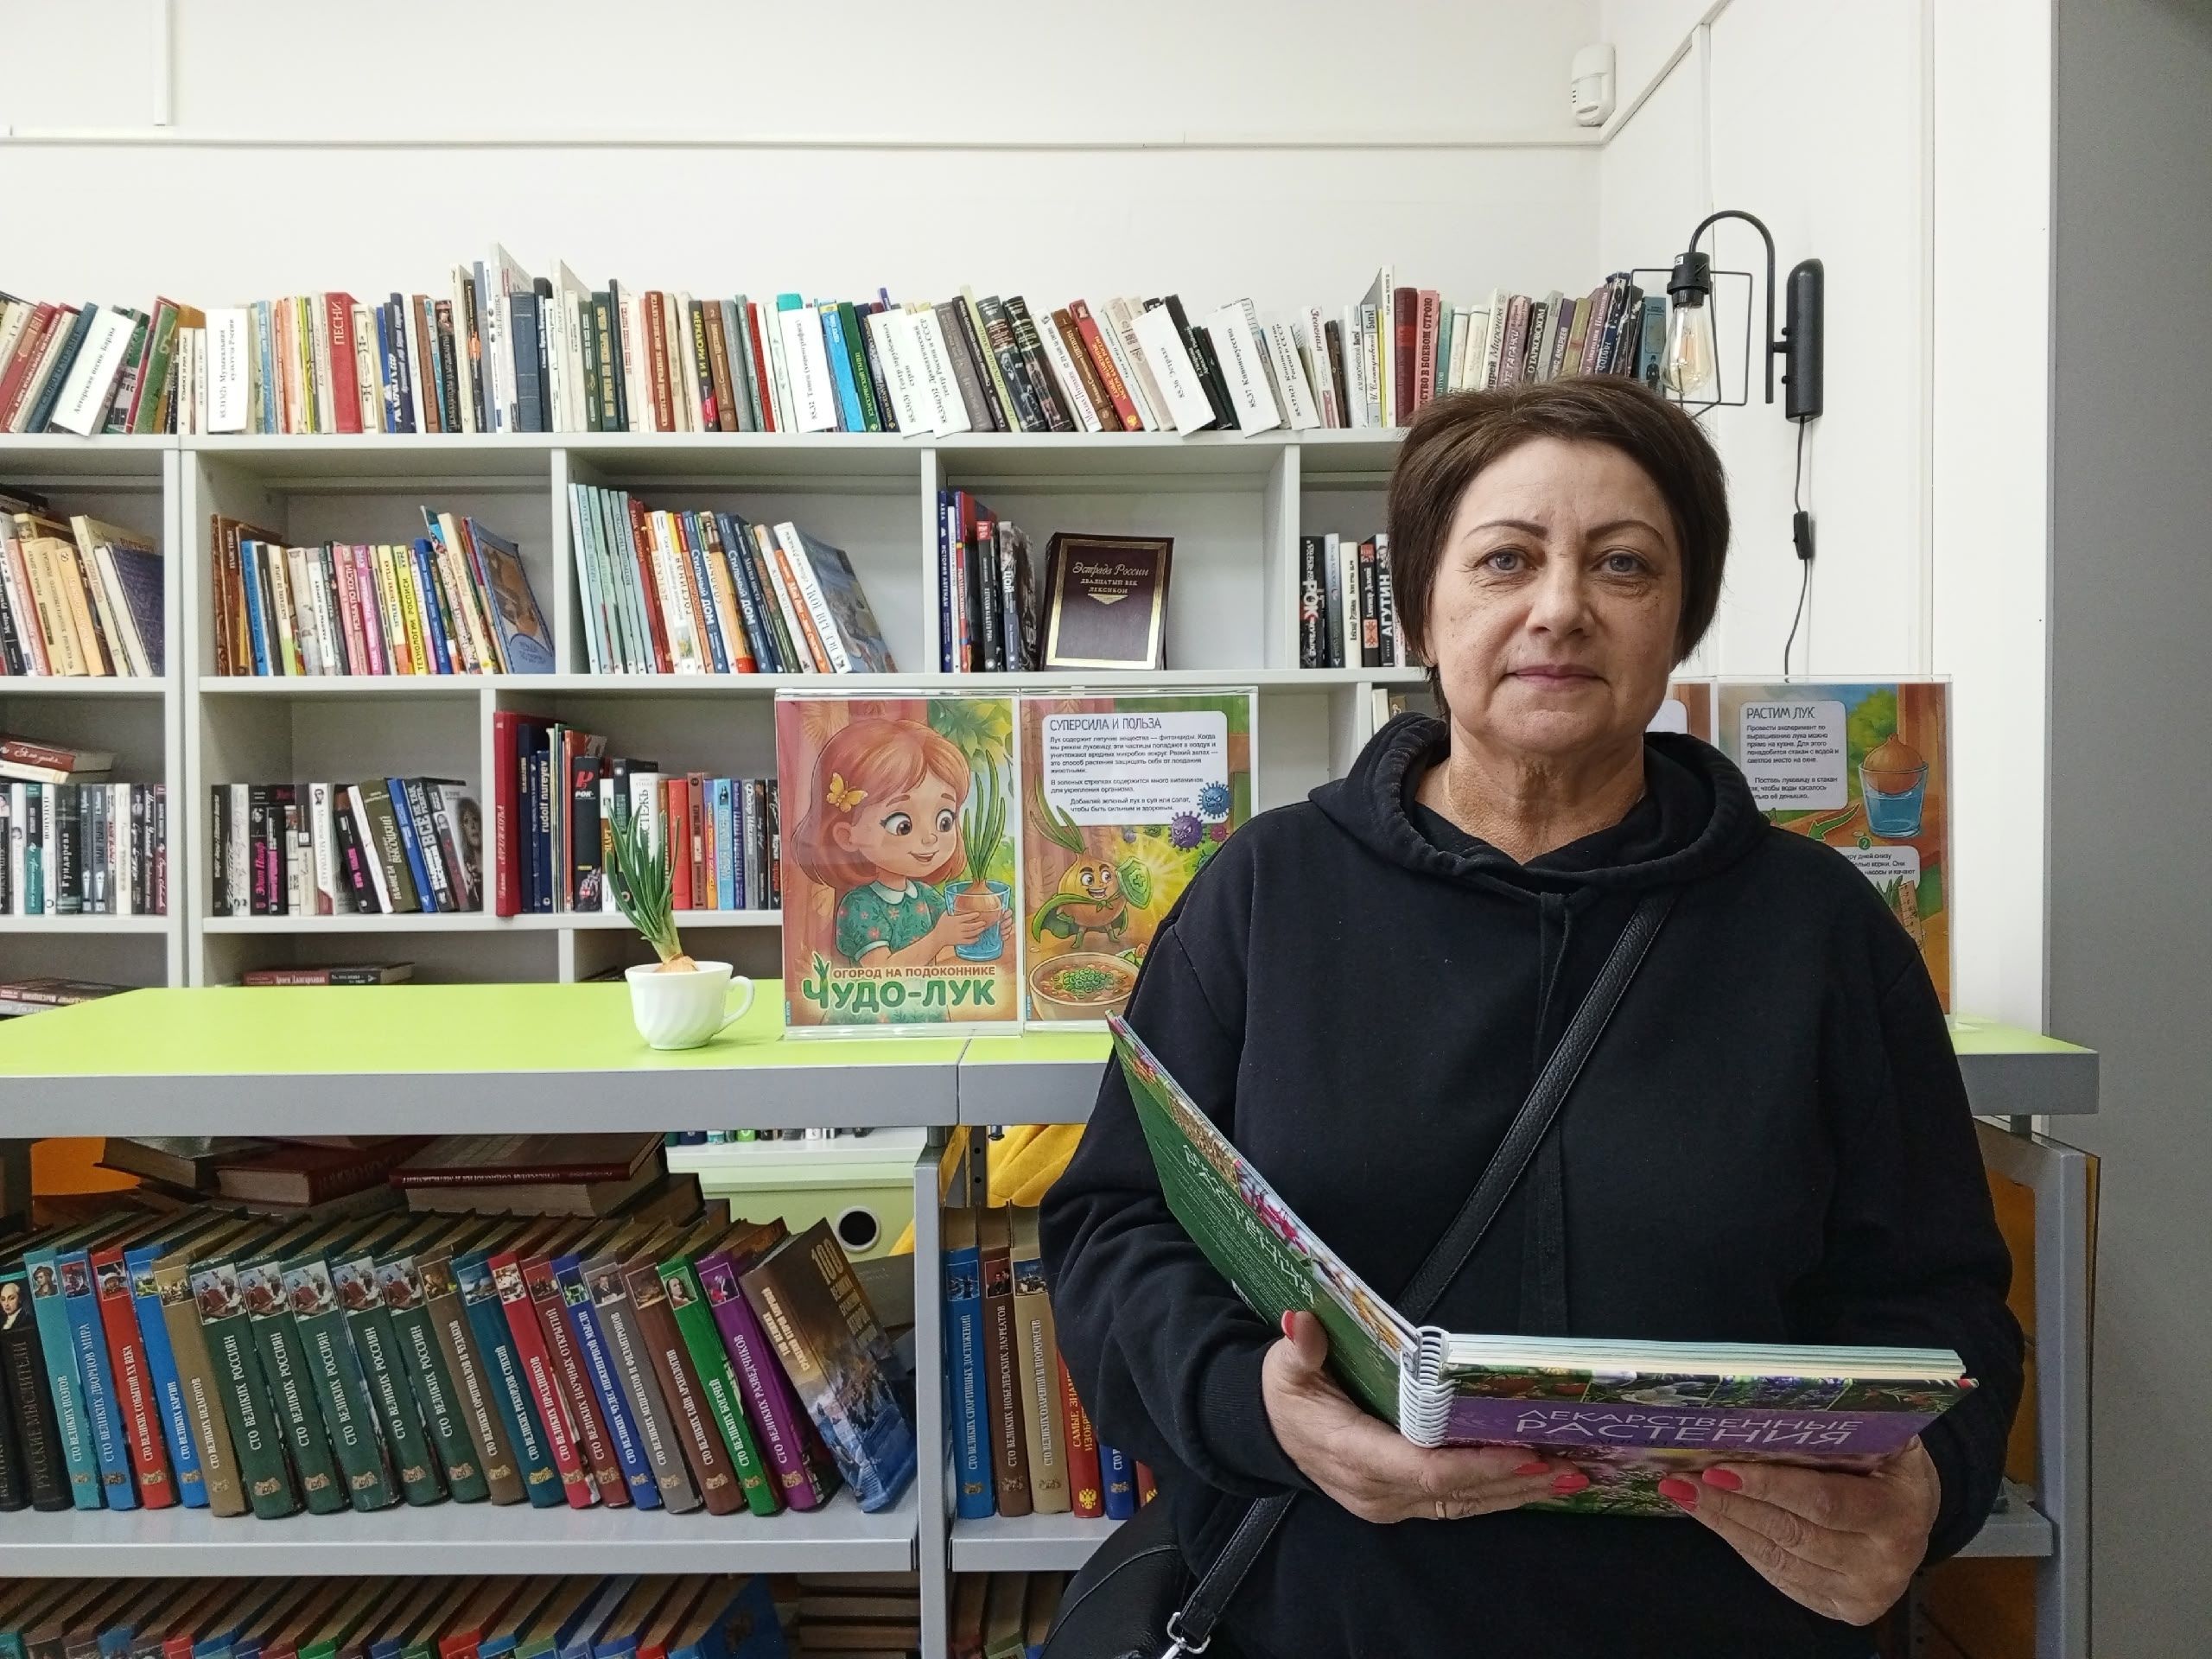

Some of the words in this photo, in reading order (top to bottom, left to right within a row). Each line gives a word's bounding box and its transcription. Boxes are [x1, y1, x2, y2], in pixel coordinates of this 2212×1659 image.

[332, 302, 345, 346] ПЕСНИ
[1365, 310, 1376, 329] Быть!
[1422, 297, 1433, 328] СТРОЮ
[694, 311, 705, 359] МЕРКЬЮРИ
[1421, 331, 1432, 368] БОЕВОМ
[1489, 307, 1503, 359] Миронов
[1528, 308, 1546, 364] ТАРКОВСКОМ
[1554, 327, 1567, 359] АНДРЕЕВ
[691, 549, 708, 597] Стильный
[701, 598, 714, 626] ДОМ
[1072, 562, 1112, 576] Эстрада
[1114, 564, 1149, 576] России
[1080, 577, 1124, 587] ДВАДЦАТЫЙ
[401, 577, 415, 615] РОСПИСИ
[728, 550, 748, 597] Стильный
[741, 598, 756, 626] ДОМ
[1379, 574, 1393, 637] АГУТИН
[410, 620, 423, 671] ТЕХНОЛОГИИ
[1050, 719, 1109, 732] СУПЕРСИЛА
[1112, 718, 1119, 730] И
[1122, 717, 1162, 730] ПОЛЬЗА
[1746, 708, 1791, 720] РАСТИМ
[1793, 707, 1815, 720] ЛУК
[539, 760, 550, 800] nureyev
[539, 802, 550, 833] rudolf
[61, 832, 73, 887] Гундарева
[833, 969, 882, 981] ОГОРОД
[886, 968, 902, 978] НА
[906, 966, 996, 980] ПОДОКОННИКЕ
[803, 979, 996, 1014] ЧУДО-ЛУК
[1185, 1149, 1313, 1303] РАСТЕНИЯ
[811, 1238, 844, 1285] 100
[79, 1323, 95, 1350] МИРА
[546, 1307, 572, 1357] ОТКРЫТИЙ
[579, 1310, 596, 1339] МЫСЛИ
[960, 1314, 974, 1366] ДОСТИЖЕНИЙ
[996, 1305, 1009, 1351] ЛАУРЕАТОВ
[122, 1344, 135, 1363] ВЕКА
[223, 1335, 245, 1381] РОССИЯН
[270, 1332, 292, 1377] РОССИЯН
[588, 1339, 613, 1390] ИНЖЕНЕРНОЙ
[734, 1333, 764, 1399] РАЗВЕДЧИКОВ
[12, 1341, 41, 1427] МЫСЛИТЕЛИ
[57, 1376, 73, 1408] ПОЭТОВ
[83, 1352, 105, 1395] ДВОРЦОВ
[531, 1357, 555, 1408] ПРАЗДНИКОВ
[562, 1357, 586, 1399] НАУЧНЫХ
[1001, 1352, 1014, 1409] НОБЕЛЕВСКИХ
[126, 1376, 144, 1412] СОБЫТИЙ
[236, 1383, 258, 1427] ВЕЛИКИХ
[284, 1380, 305, 1424] ВЕЛИКИХ
[607, 1390, 622, 1414] ЧУДЕС
[709, 1378, 731, 1414] БОГАЧЕЙ
[963, 1367, 976, 1419] СПОРТИВНЫХ
[63, 1408, 79, 1445] ВЕЛИКИХ
[93, 1398, 111, 1440] ВЕЛИКИХ
[133, 1412, 151, 1446] ВЕЛИКИХ
[296, 1427, 310, 1446] СТО
[549, 1408, 568, 1445] ВЕЛИКИХ
[578, 1400, 600, 1440] ВЕЛИКИХ
[614, 1414, 634, 1449] ВЕЛИКИХ
[724, 1413, 747, 1450] ВЕЛИКИХ
[757, 1399, 779, 1442] ВЕЛИКИХ
[966, 1419, 977, 1453] ВЕЛИКИХ
[1004, 1411, 1016, 1448] ВЕЛИКИХ
[1071, 1410, 1082, 1447] САМЫЕ
[1516, 1418, 1853, 1446] РАСТЕНИЯ
[1517, 1409, 1864, 1431] ЛЕКАРСТВЕННЫЕ
[70, 1446, 82, 1462] СТО
[102, 1443, 116, 1463] СТО
[141, 1446, 154, 1461] СТО
[248, 1430, 262, 1450] СТО
[561, 1446, 571, 1460] СТО
[592, 1441, 605, 1460] СТО
[626, 1450, 638, 1464] СТО
[739, 1450, 750, 1467] СТО
[773, 1444, 788, 1464] СТО
[29, 1430, 51, 1489] РУССКИЕ
[968, 1455, 978, 1470] СТО
[1007, 1451, 1017, 1467] СТО
